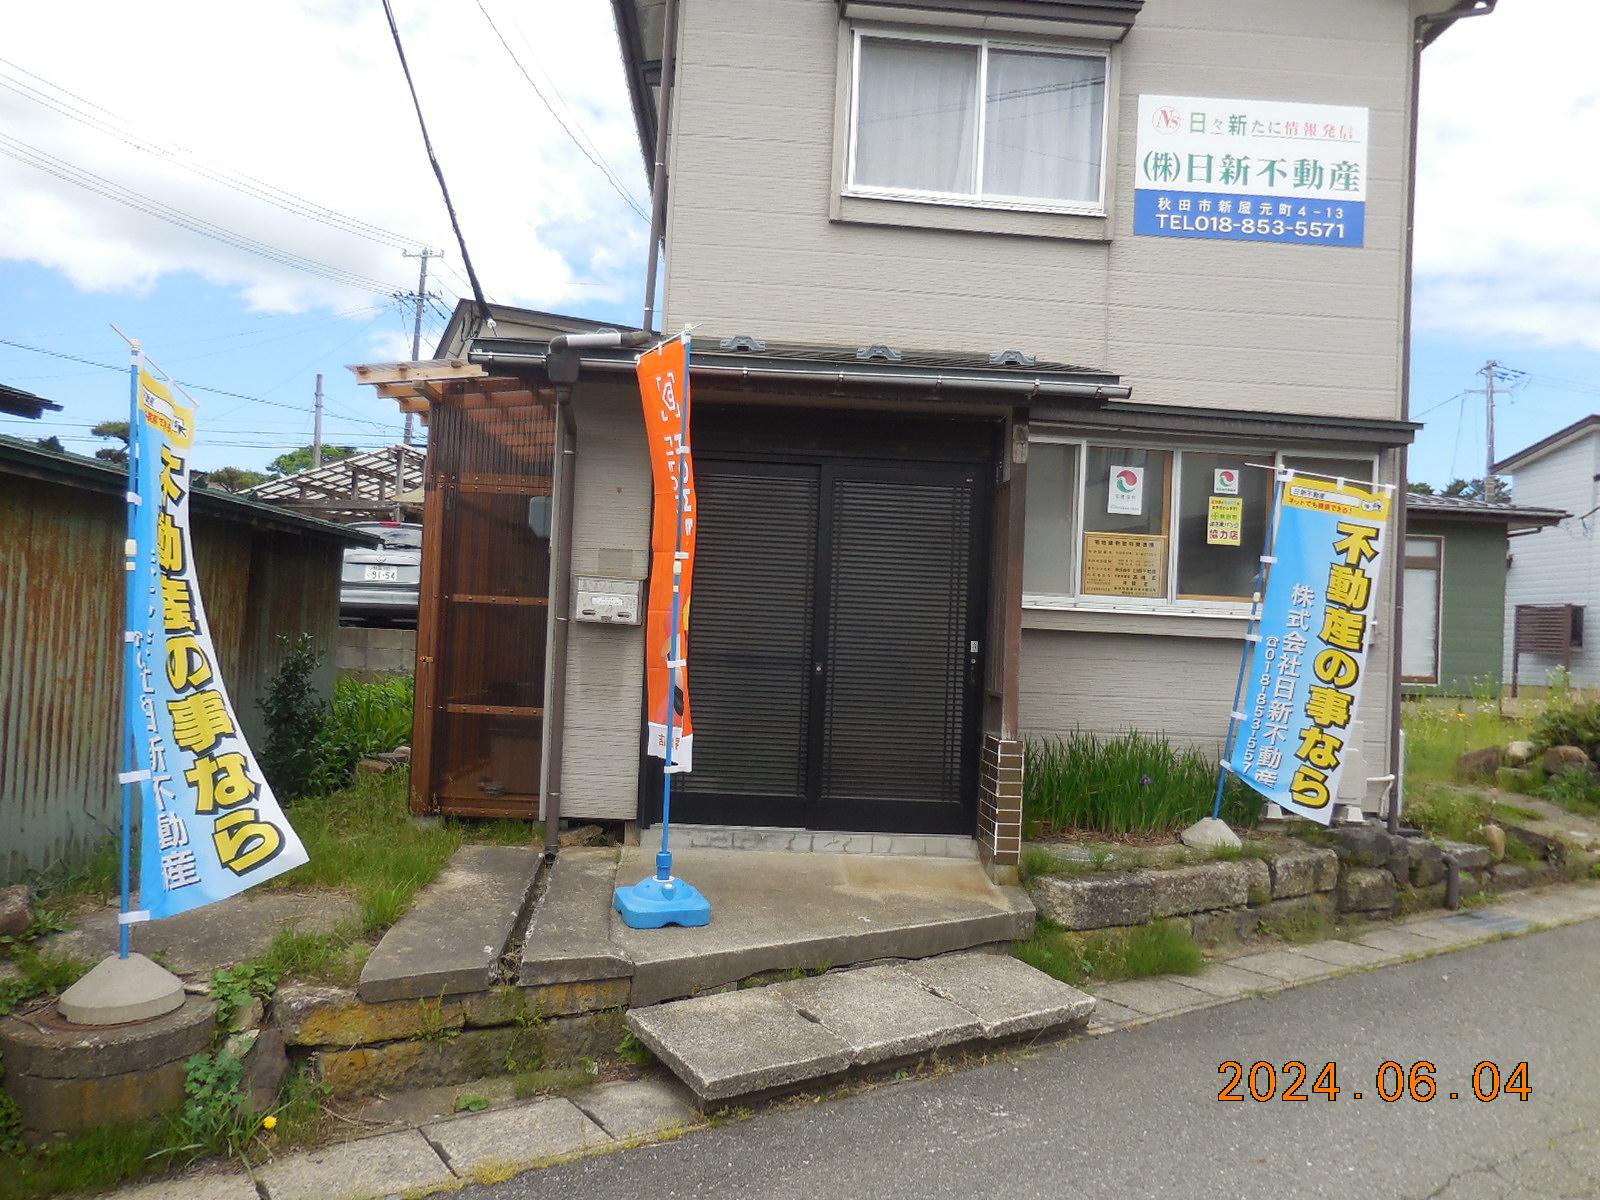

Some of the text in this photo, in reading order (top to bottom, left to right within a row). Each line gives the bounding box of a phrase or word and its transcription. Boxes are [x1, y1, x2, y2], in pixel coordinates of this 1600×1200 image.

[1189, 111, 1353, 140] 日々新たに情報発信
[1143, 150, 1361, 193] (株)日新不動産
[1156, 214, 1345, 238] TEL018-853-5571
[1209, 529, 1239, 541] 協力店
[1290, 521, 1380, 808] 不動産の事なら
[1255, 583, 1316, 789] 株式会社日新不動産
